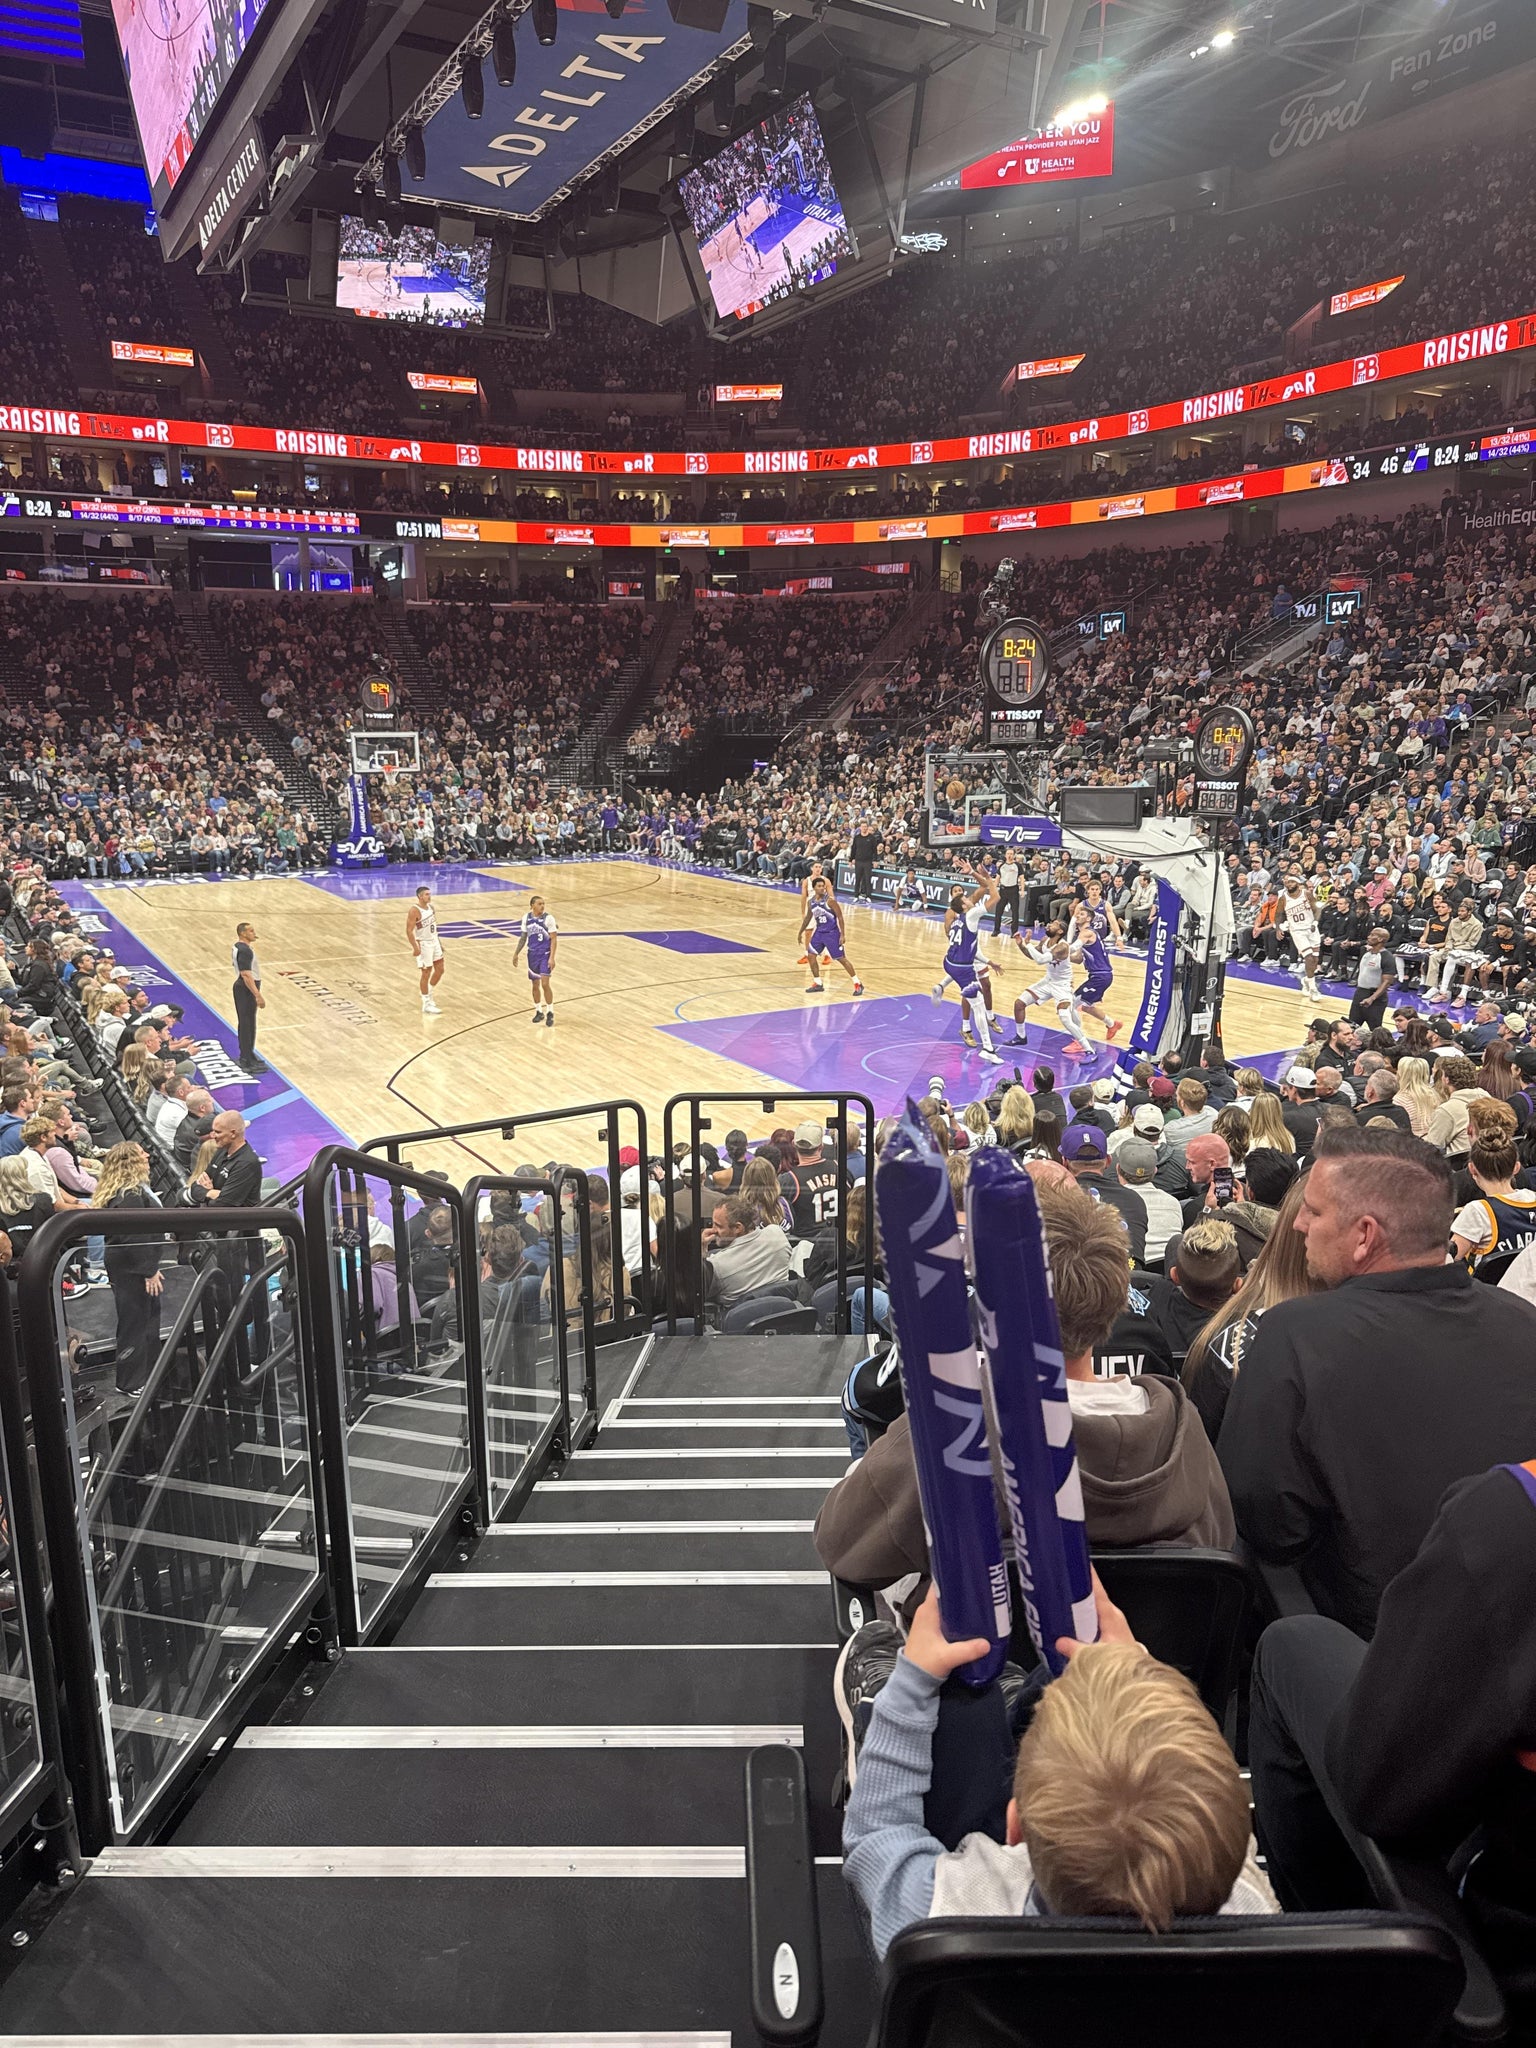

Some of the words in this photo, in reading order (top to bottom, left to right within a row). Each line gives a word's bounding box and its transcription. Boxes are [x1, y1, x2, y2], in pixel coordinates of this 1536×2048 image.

[1389, 49, 1431, 82] Fan
[1437, 20, 1497, 62] Zone
[487, 34, 666, 156] DELTA
[1069, 120, 1100, 136] YOU
[1269, 79, 1372, 158] Ford
[1025, 142, 1054, 150] PROVIDER
[1086, 137, 1099, 145] JAZZ
[1042, 157, 1074, 168] HEALTH
[205, 188, 230, 239] DELTA
[228, 138, 259, 199] CENTER
[802, 204, 828, 224] UTAH
[1424, 324, 1508, 368] RAISING
[1353, 354, 1379, 387] PB
[1183, 388, 1244, 423] RAISING
[1282, 371, 1316, 400] BAR
[0, 407, 80, 435] RAISING
[132, 420, 169, 442] BAR
[1128, 410, 1149, 435] PB
[275, 430, 347, 457] RAISING
[390, 442, 421, 462] BAR
[969, 430, 1031, 457] RAISING
[1069, 420, 1099, 443] BAR
[1471, 441, 1476, 450] 7
[1490, 435, 1509, 447] 13/32
[1511, 432, 1530, 442] (41%)
[456, 444, 480, 466] PB
[745, 452, 808, 472] RAISING
[847, 447, 878, 469] BAR
[1434, 445, 1460, 466] 8:24
[1464, 452, 1478, 462] 2ND
[1488, 447, 1508, 458] 14/32
[1509, 443, 1530, 455] (44%)
[517, 449, 583, 471] RAISING
[624, 453, 654, 472] BAR
[685, 453, 708, 474] PB
[1380, 456, 1399, 474] 46
[1353, 461, 1370, 480] 34
[25, 500, 52, 517] 8:24
[57, 510, 71, 518] 2ND
[61, 501, 67, 509] 7
[80, 512, 99, 520] 14/32
[100, 512, 119, 521] (44%)
[143, 515, 161, 523] (47%)
[173, 516, 188, 524] 10/11
[1465, 508, 1536, 530] HealthEqu
[396, 521, 423, 538] 07:51
[424, 523, 441, 539] PM
[1332, 600, 1356, 616] LVT
[1004, 639, 1036, 658] 8:24
[1016, 659, 1032, 694] 7
[370, 683, 390, 693] 8:24
[379, 692, 389, 708] 7
[1006, 710, 1042, 720] TISSOT
[1214, 727, 1242, 744] 8:24
[1224, 746, 1233, 766] 7
[1208, 781, 1240, 790] TISSOT
[357, 787, 365, 805] FIRST
[359, 805, 367, 833] AMERICA
[83, 872, 208, 890] UTAH
[221, 870, 338, 882] JAZZ
[926, 885, 943, 900] LVT
[1093, 921, 1103, 929] 23
[1292, 913, 1305, 923] 00
[537, 933, 544, 942] 3
[948, 929, 962, 946] 24
[1140, 968, 1164, 1042] AMERICA
[1154, 917, 1168, 966] FIRST
[288, 976, 334, 998] DELTA
[321, 998, 378, 1026] CENTER
[806, 1173, 836, 1192] NASH
[812, 1189, 838, 1222] 13
[989, 1563, 1007, 1606] UTAH
